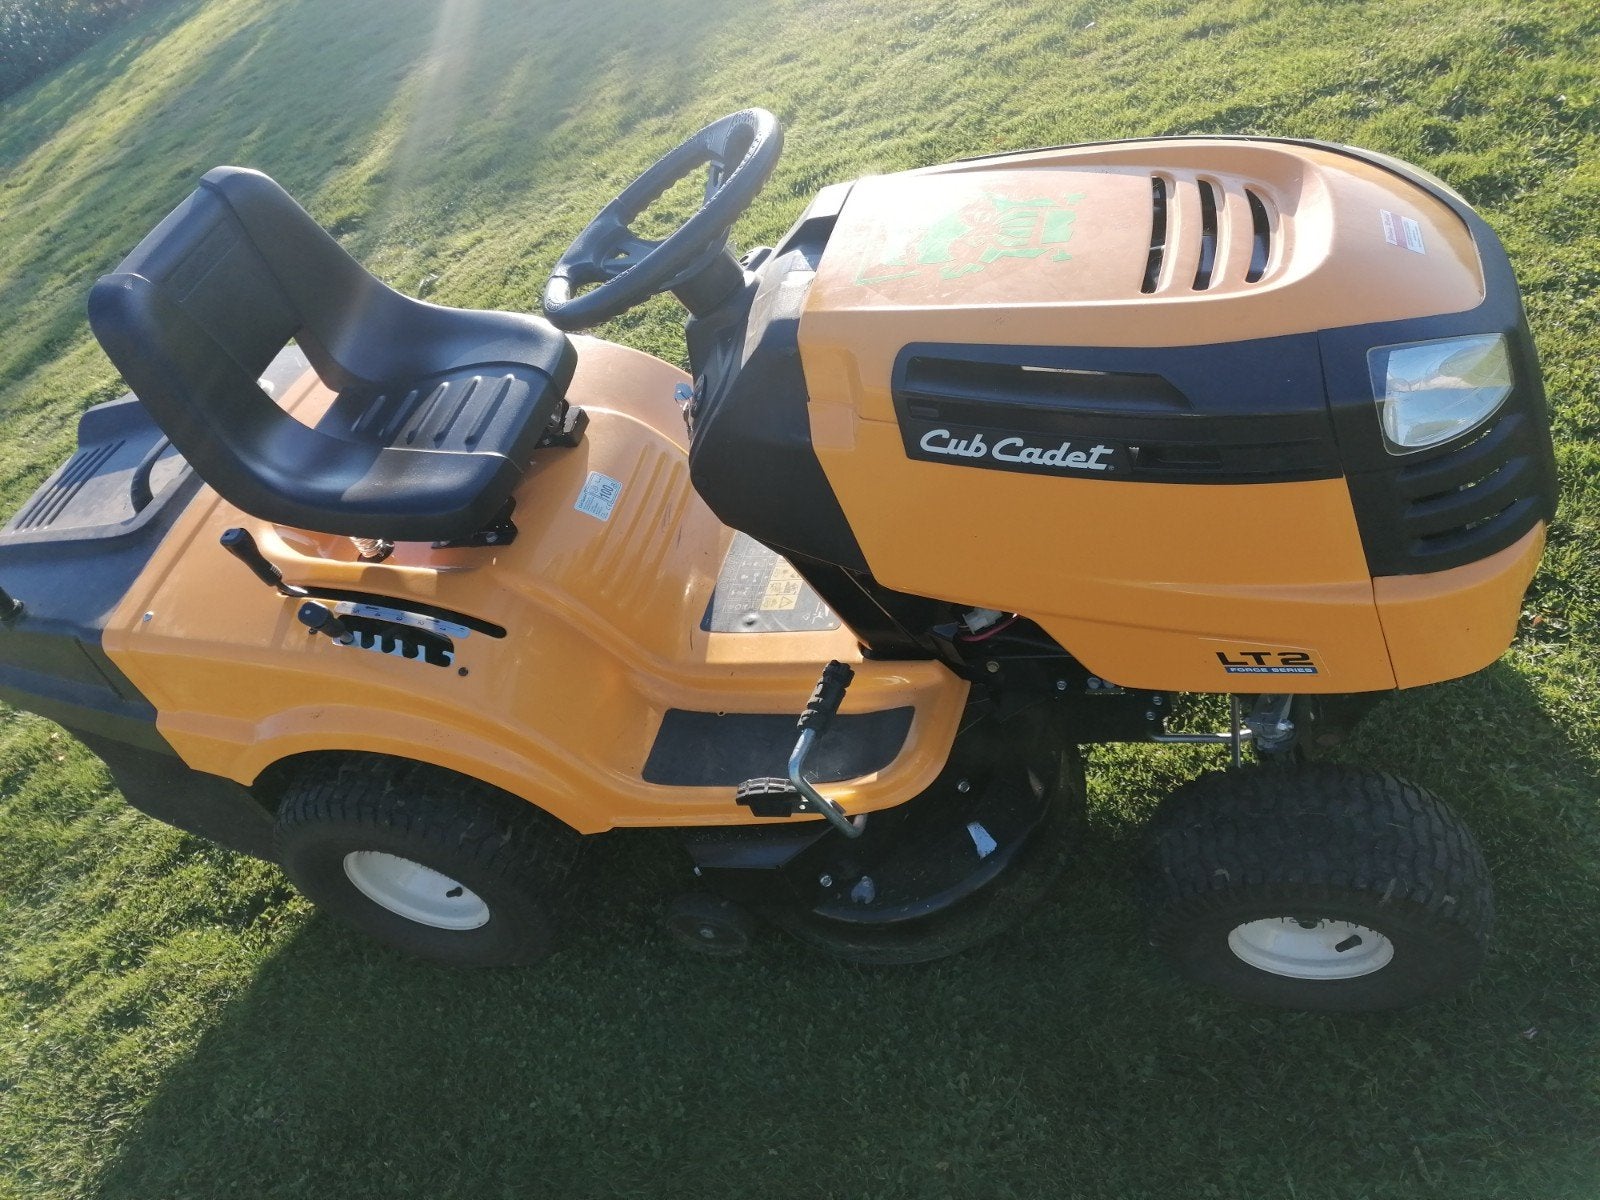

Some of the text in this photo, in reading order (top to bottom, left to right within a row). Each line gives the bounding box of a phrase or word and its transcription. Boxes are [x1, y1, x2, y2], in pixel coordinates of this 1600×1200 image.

[919, 428, 1114, 471] Cub Cadet
[600, 484, 613, 499] 100
[1215, 651, 1315, 666] LT2
